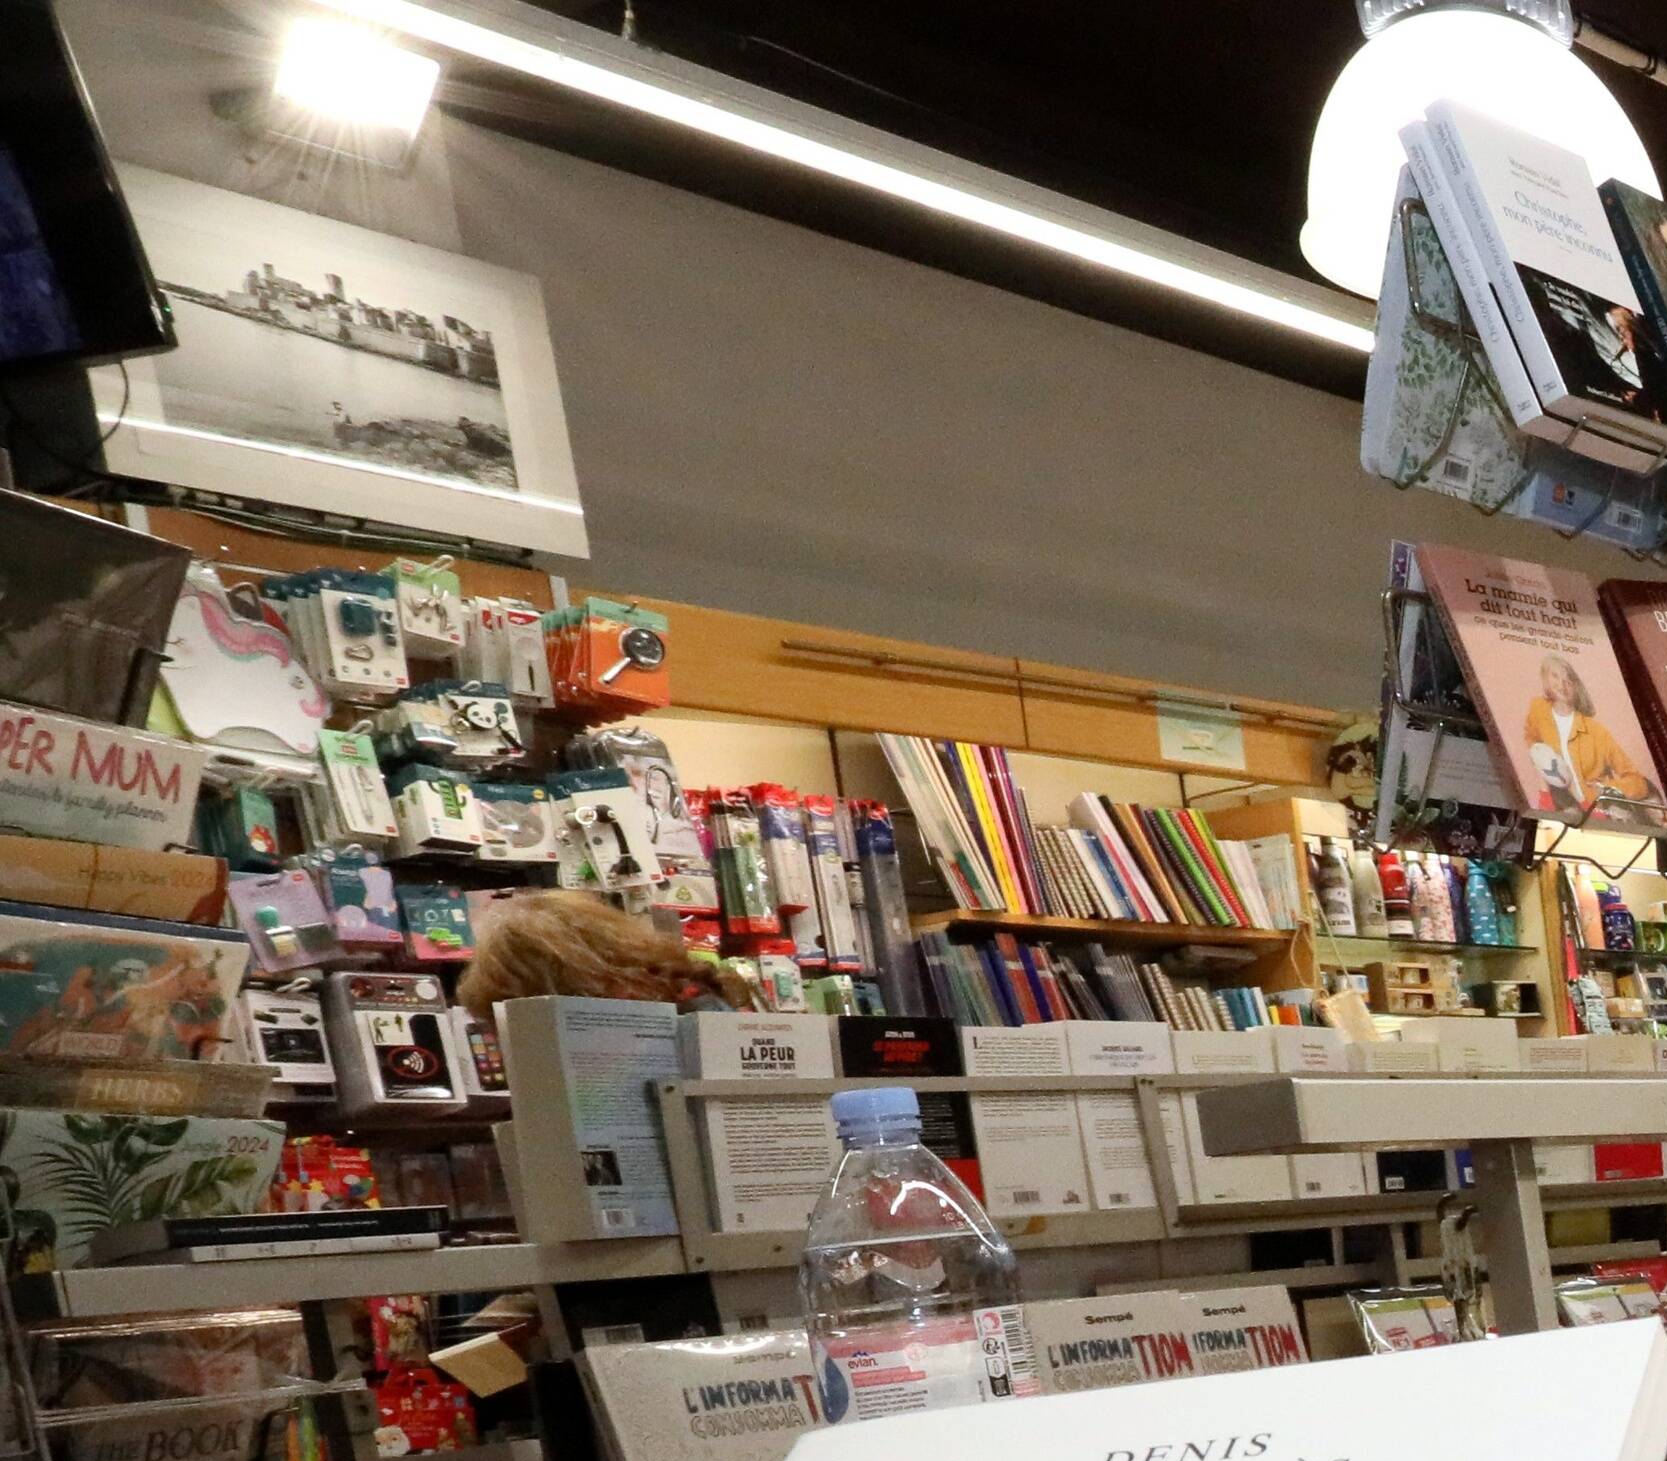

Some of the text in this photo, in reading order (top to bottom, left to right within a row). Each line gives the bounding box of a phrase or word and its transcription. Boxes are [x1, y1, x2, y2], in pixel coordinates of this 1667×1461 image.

[1465, 578, 1486, 595] La
[1491, 586, 1547, 607] mamie
[1480, 599, 1577, 629] dit tout haut
[70, 730, 182, 804] MUM
[741, 1046, 795, 1061] LA PEUR
[227, 1136, 270, 1153] 2024
[1084, 1311, 1133, 1326] Sempé
[1202, 1303, 1247, 1317] Sempé
